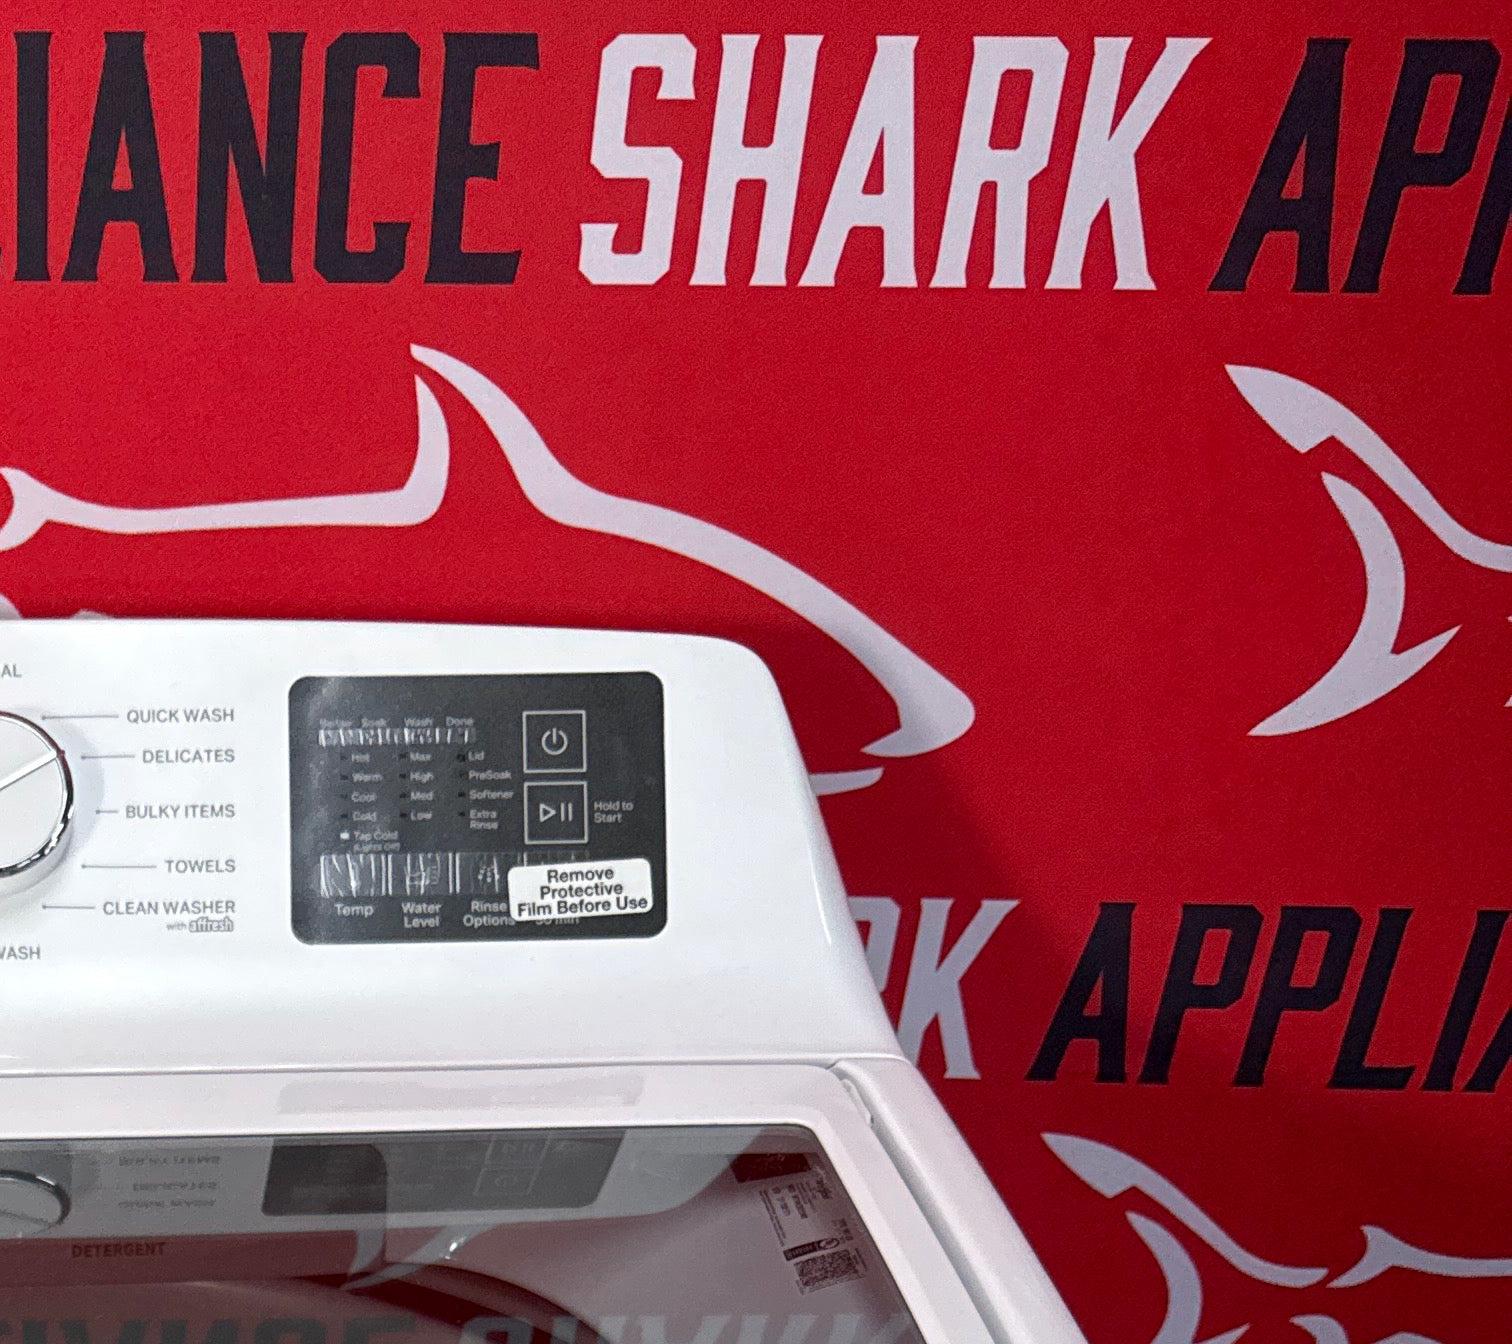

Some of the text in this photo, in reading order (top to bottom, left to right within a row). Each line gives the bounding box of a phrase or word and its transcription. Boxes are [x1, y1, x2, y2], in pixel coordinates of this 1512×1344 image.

[578, 33, 1213, 291] SHARK
[126, 708, 235, 724] QUICK WASH
[142, 748, 235, 764] DELICATES
[468, 751, 485, 761] Lid
[410, 771, 434, 784] High
[410, 790, 434, 801] Med
[125, 803, 236, 819] BULKY ITEMS
[593, 801, 634, 812] Hold to
[469, 809, 497, 820] Extra
[593, 812, 623, 824] Start
[165, 858, 236, 874] TOWELS
[547, 868, 615, 884] Remove
[540, 882, 624, 901] Protective
[102, 900, 236, 916] CLEAN WASHER
[334, 903, 375, 918] Temp
[401, 901, 442, 914] Water
[471, 900, 508, 912] Rinse
[517, 895, 649, 918] Film Before Use
[189, 916, 235, 933] affresh
[403, 914, 440, 929] Level
[463, 914, 516, 929] Options
[70, 1241, 167, 1258] DETERGENT
